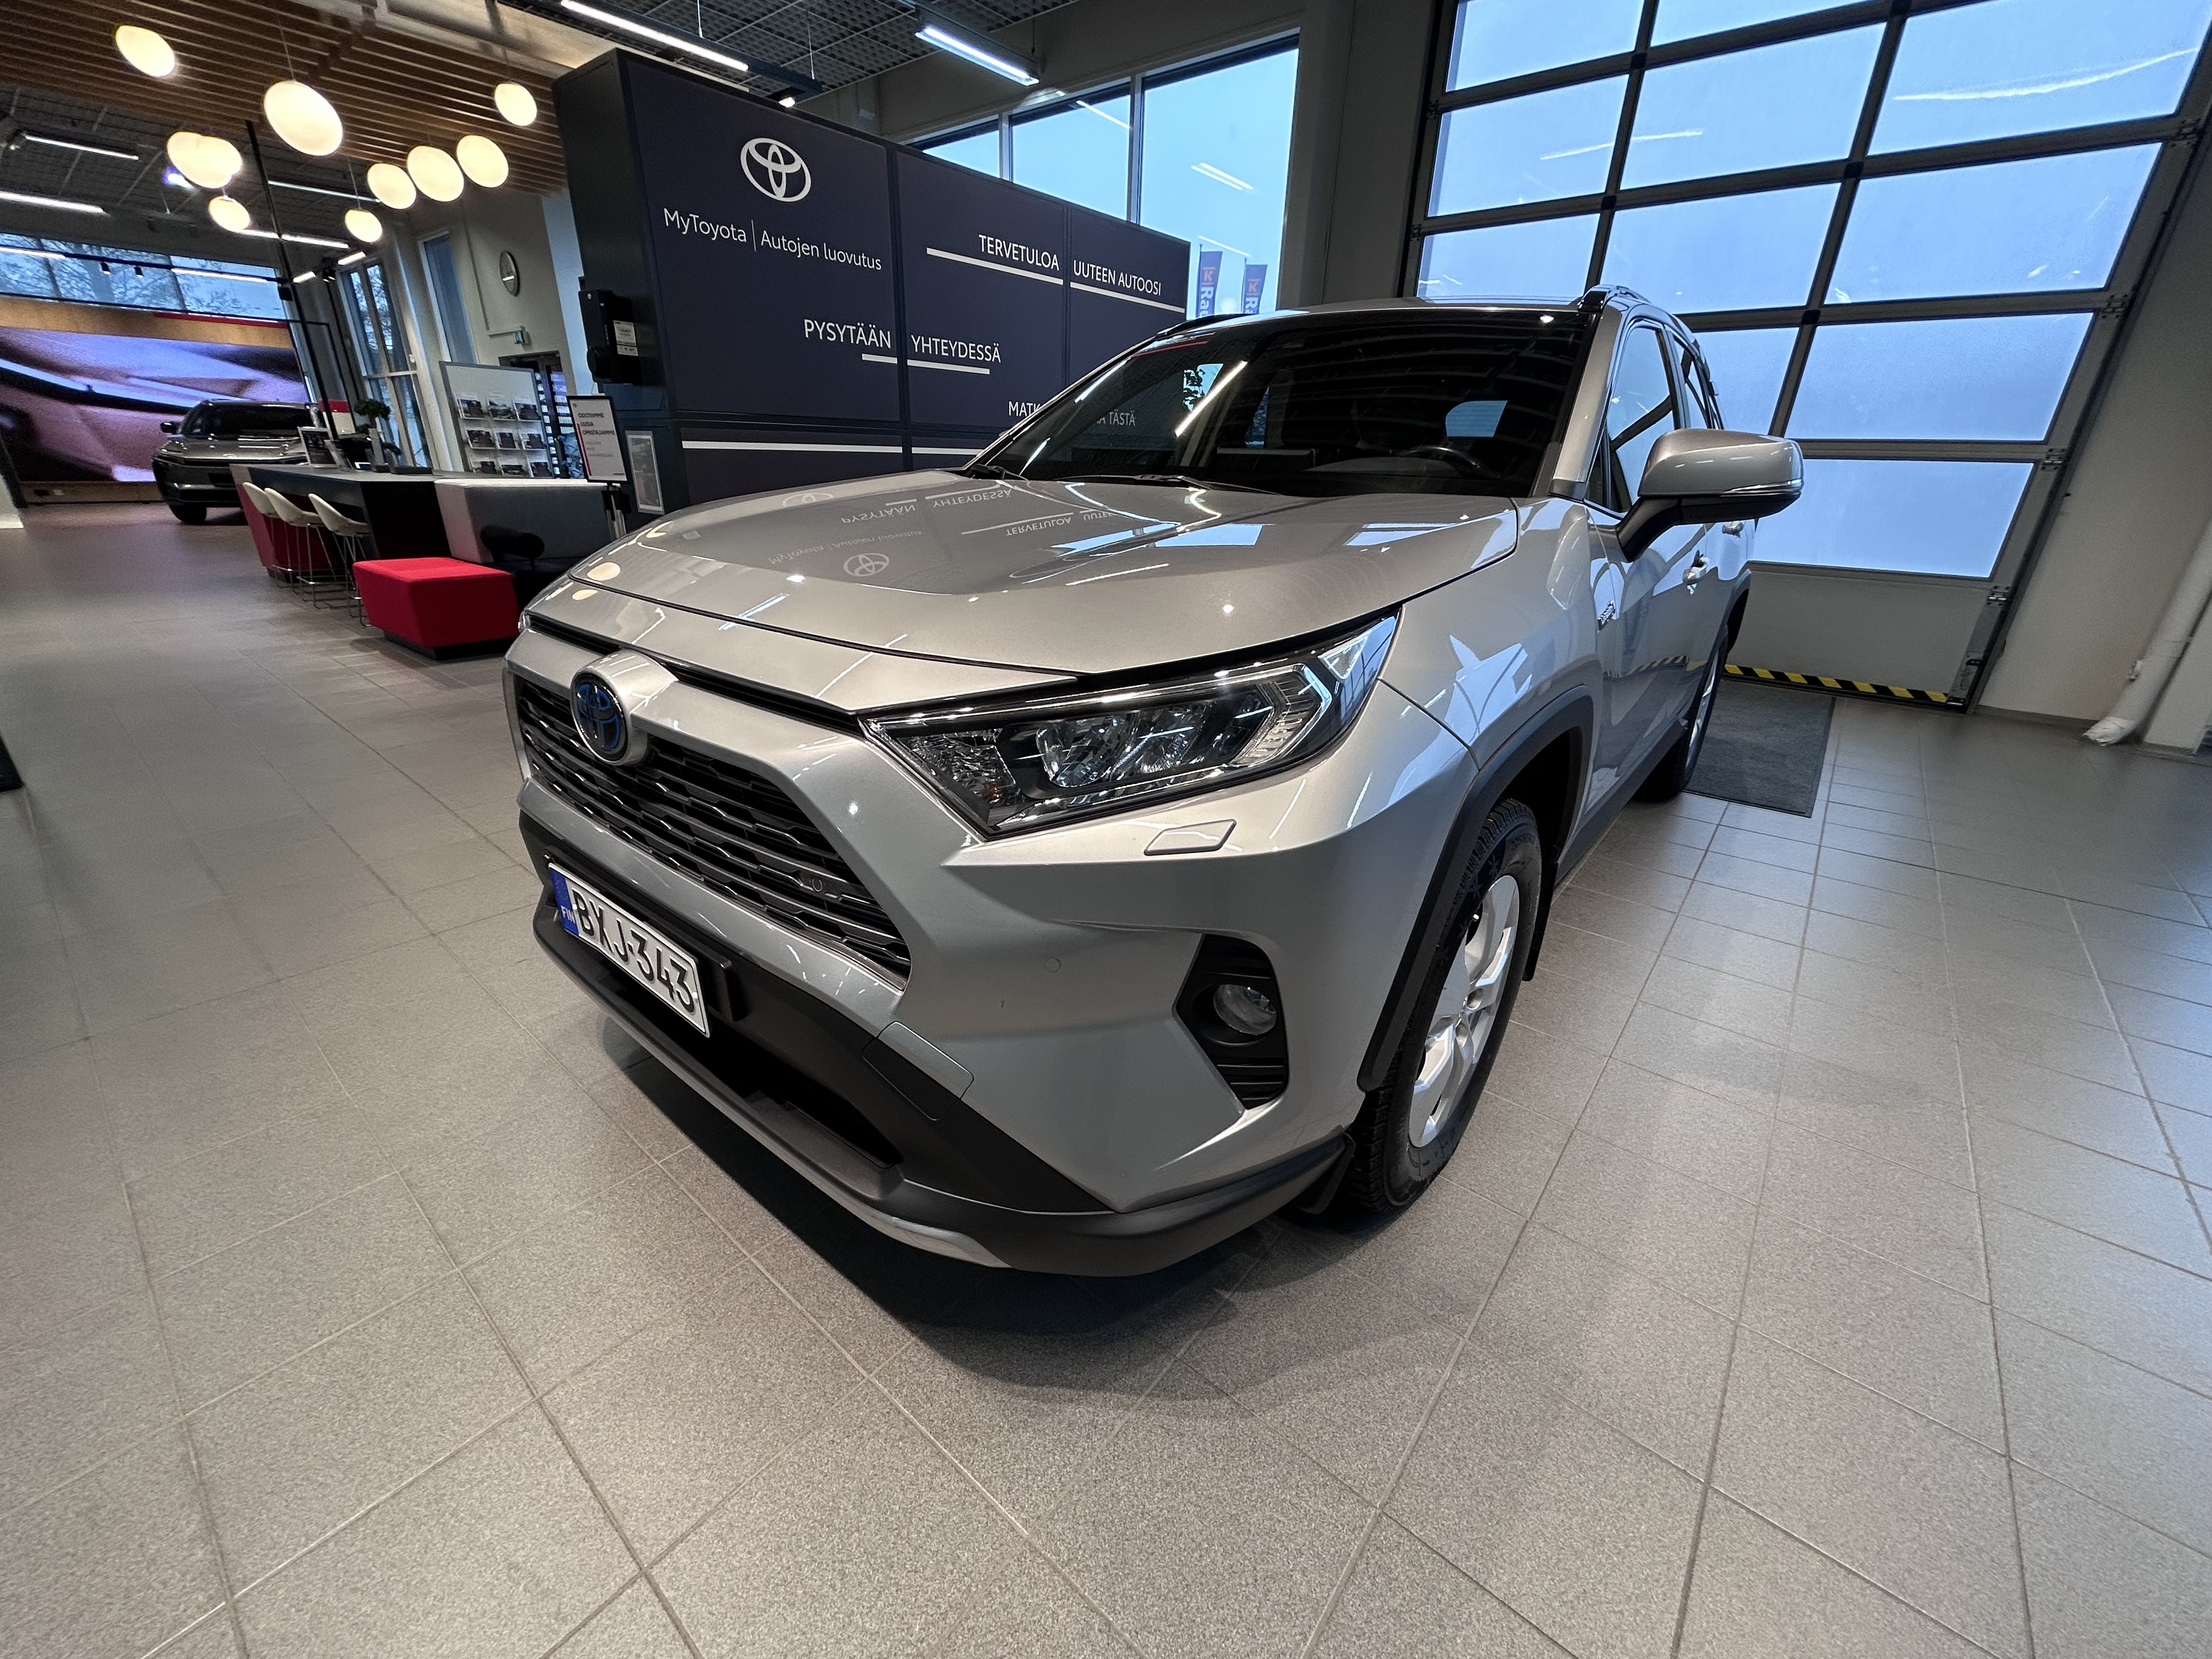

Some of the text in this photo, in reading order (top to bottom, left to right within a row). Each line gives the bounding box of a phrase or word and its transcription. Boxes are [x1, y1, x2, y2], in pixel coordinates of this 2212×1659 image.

[663, 207, 882, 270] MyToyota Autojen luovutus
[978, 234, 1161, 296] TERVETULOA UUTEEN AUTOOSI
[804, 319, 1001, 363] PYSYTÄÄN YHTEYDESSÄ
[1109, 409, 1136, 427] TÄSTÄ
[561, 906, 576, 924] FIN
[572, 887, 695, 1013] BXJ-343
